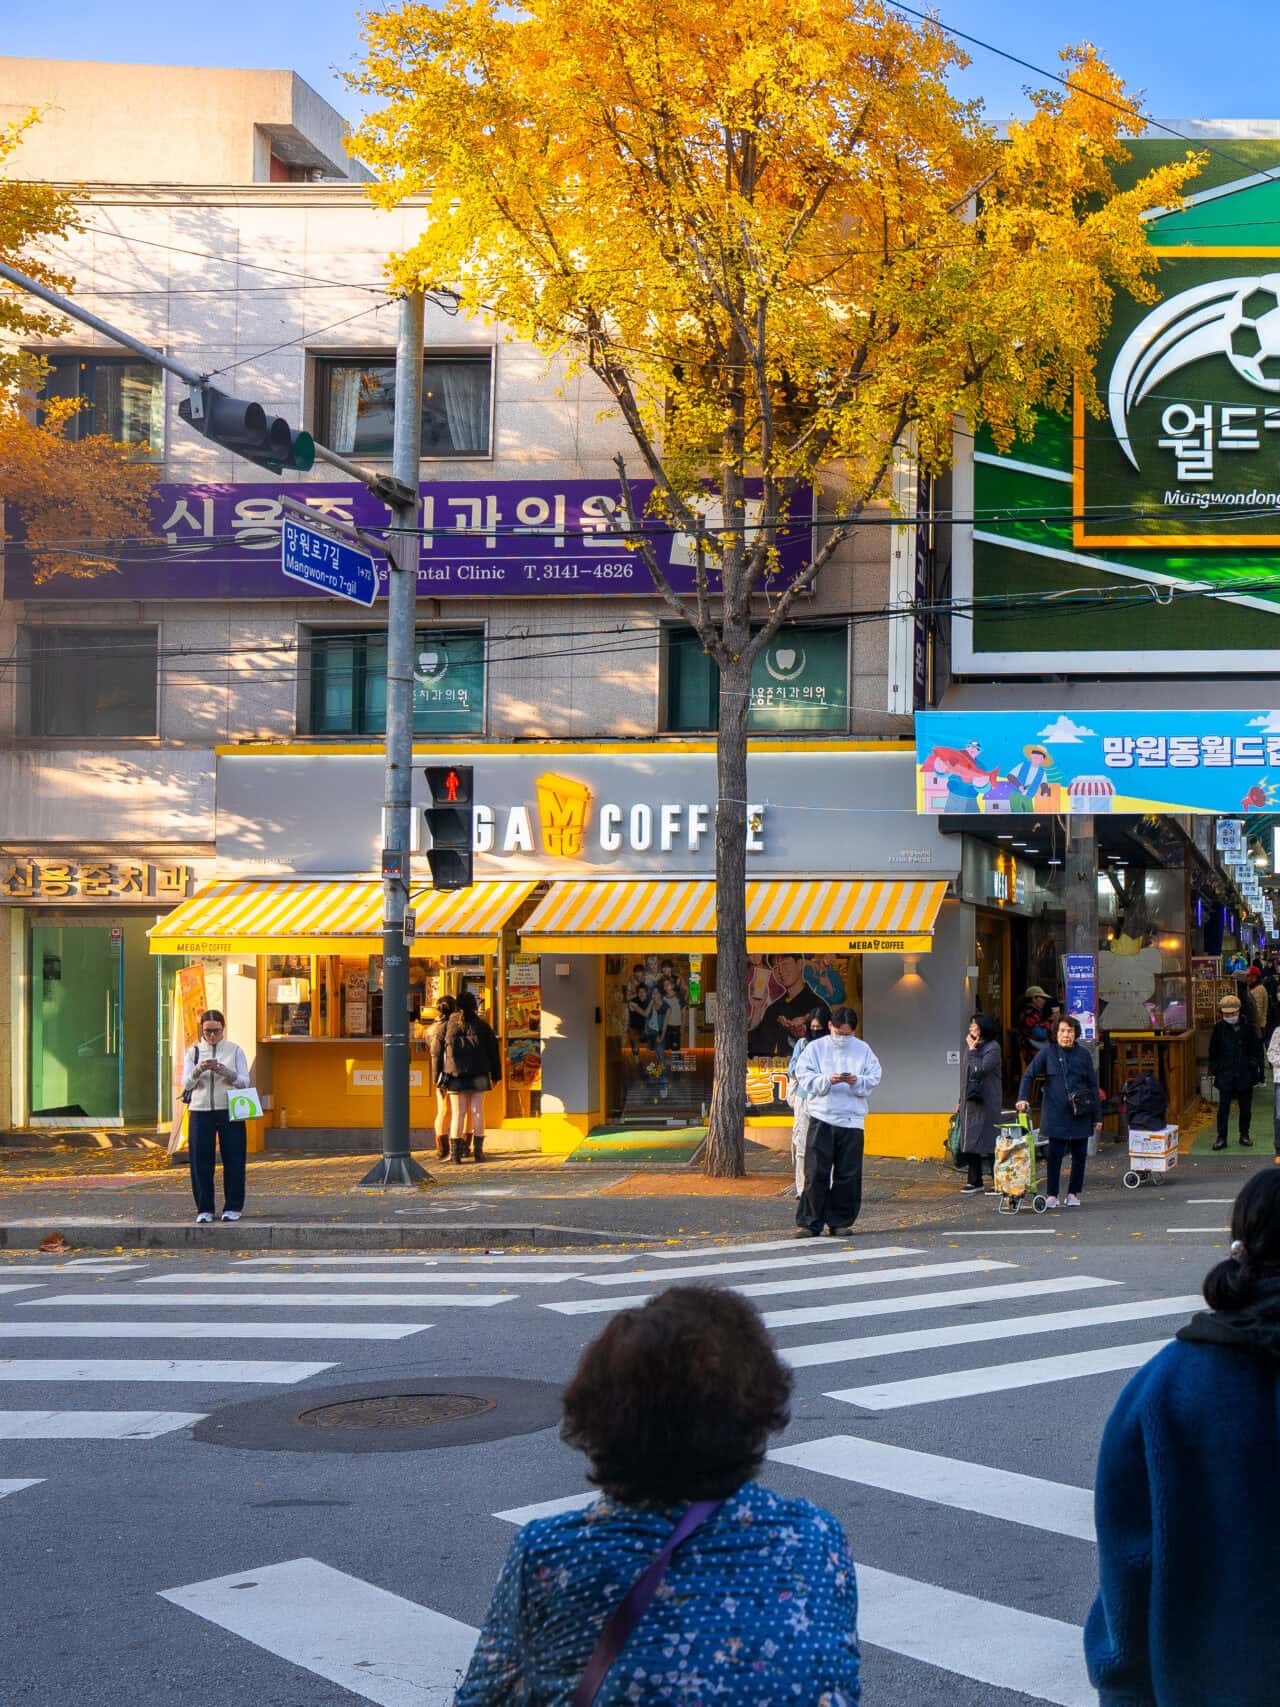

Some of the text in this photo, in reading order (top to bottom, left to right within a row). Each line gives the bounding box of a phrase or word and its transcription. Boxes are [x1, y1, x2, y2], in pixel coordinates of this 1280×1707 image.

[286, 527, 340, 570] 망원로7길
[286, 554, 357, 595] Mangwon-ro 7-gil
[418, 565, 450, 580] ntal
[457, 565, 505, 580] Clinic
[600, 803, 766, 851] COFFE
[3, 863, 193, 897] 신용준치과
[177, 943, 232, 952] MEGA COFFEE
[849, 941, 905, 950] MEGA COFFEE
